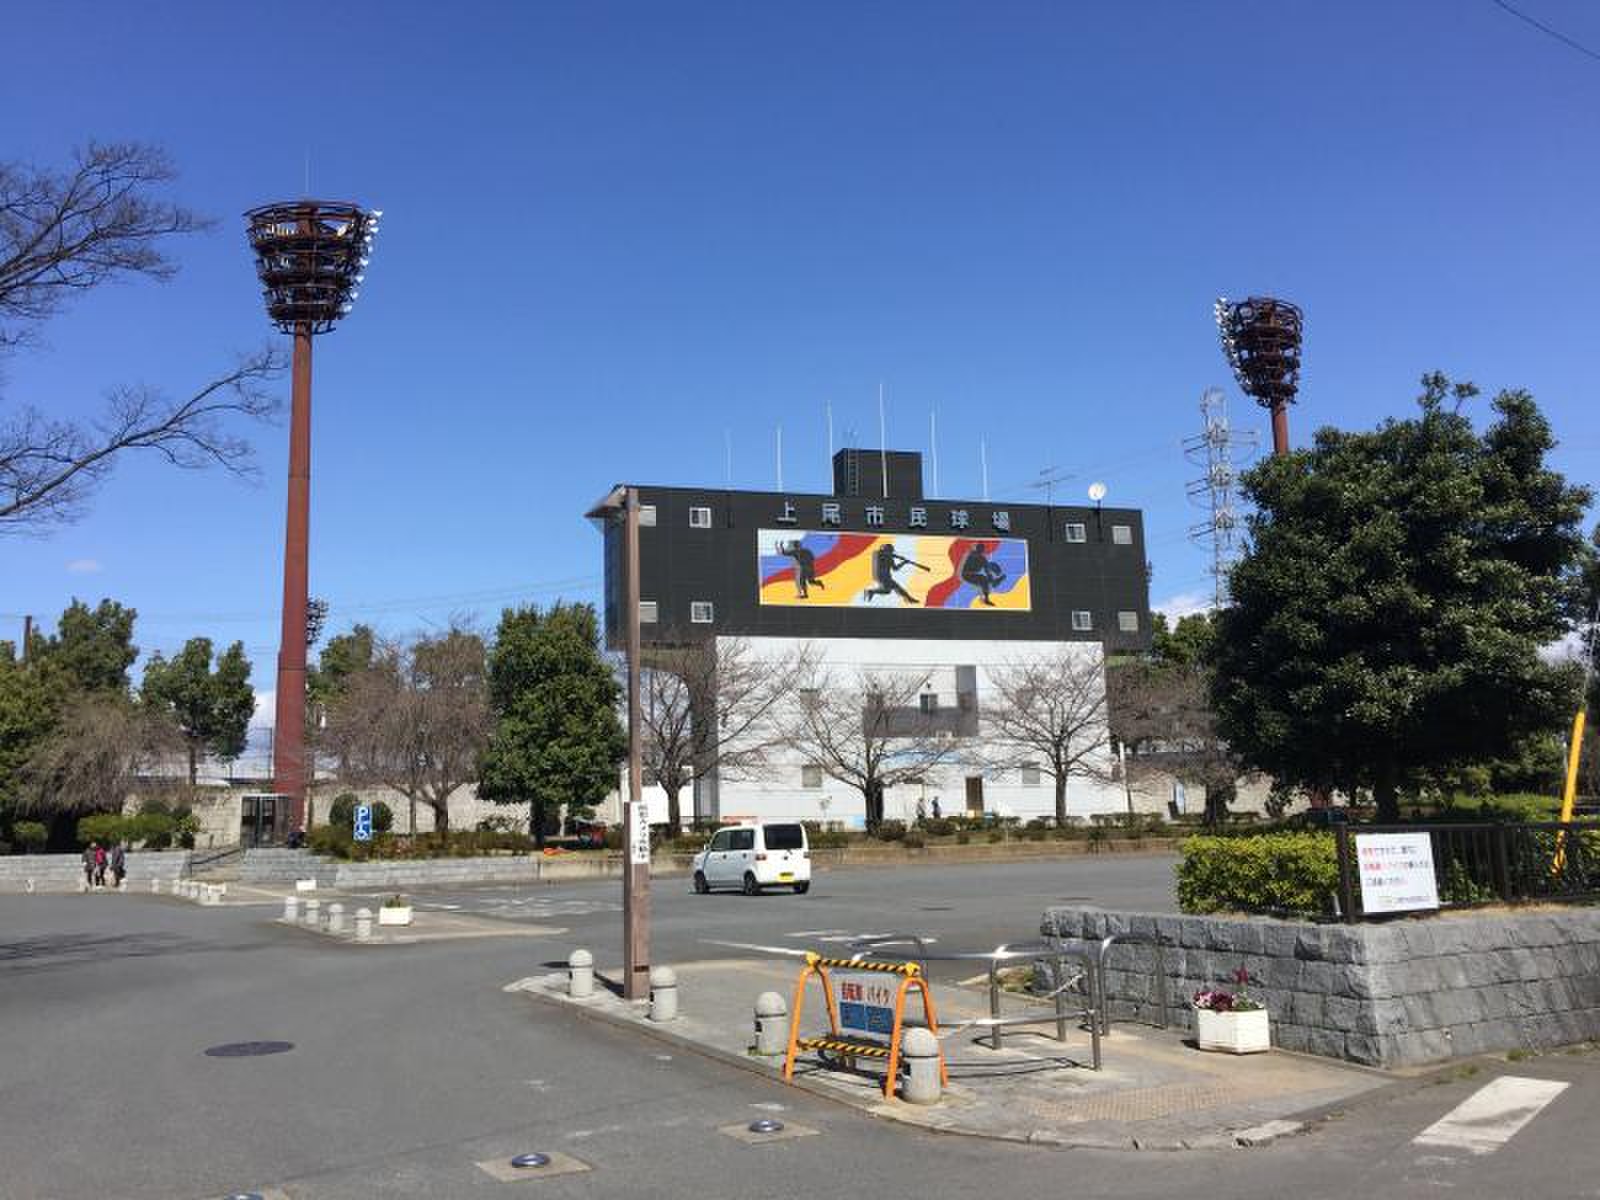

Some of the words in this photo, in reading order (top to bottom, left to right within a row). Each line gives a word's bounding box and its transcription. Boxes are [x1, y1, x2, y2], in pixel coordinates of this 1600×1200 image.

[777, 501, 1010, 530] 上尾市民球場
